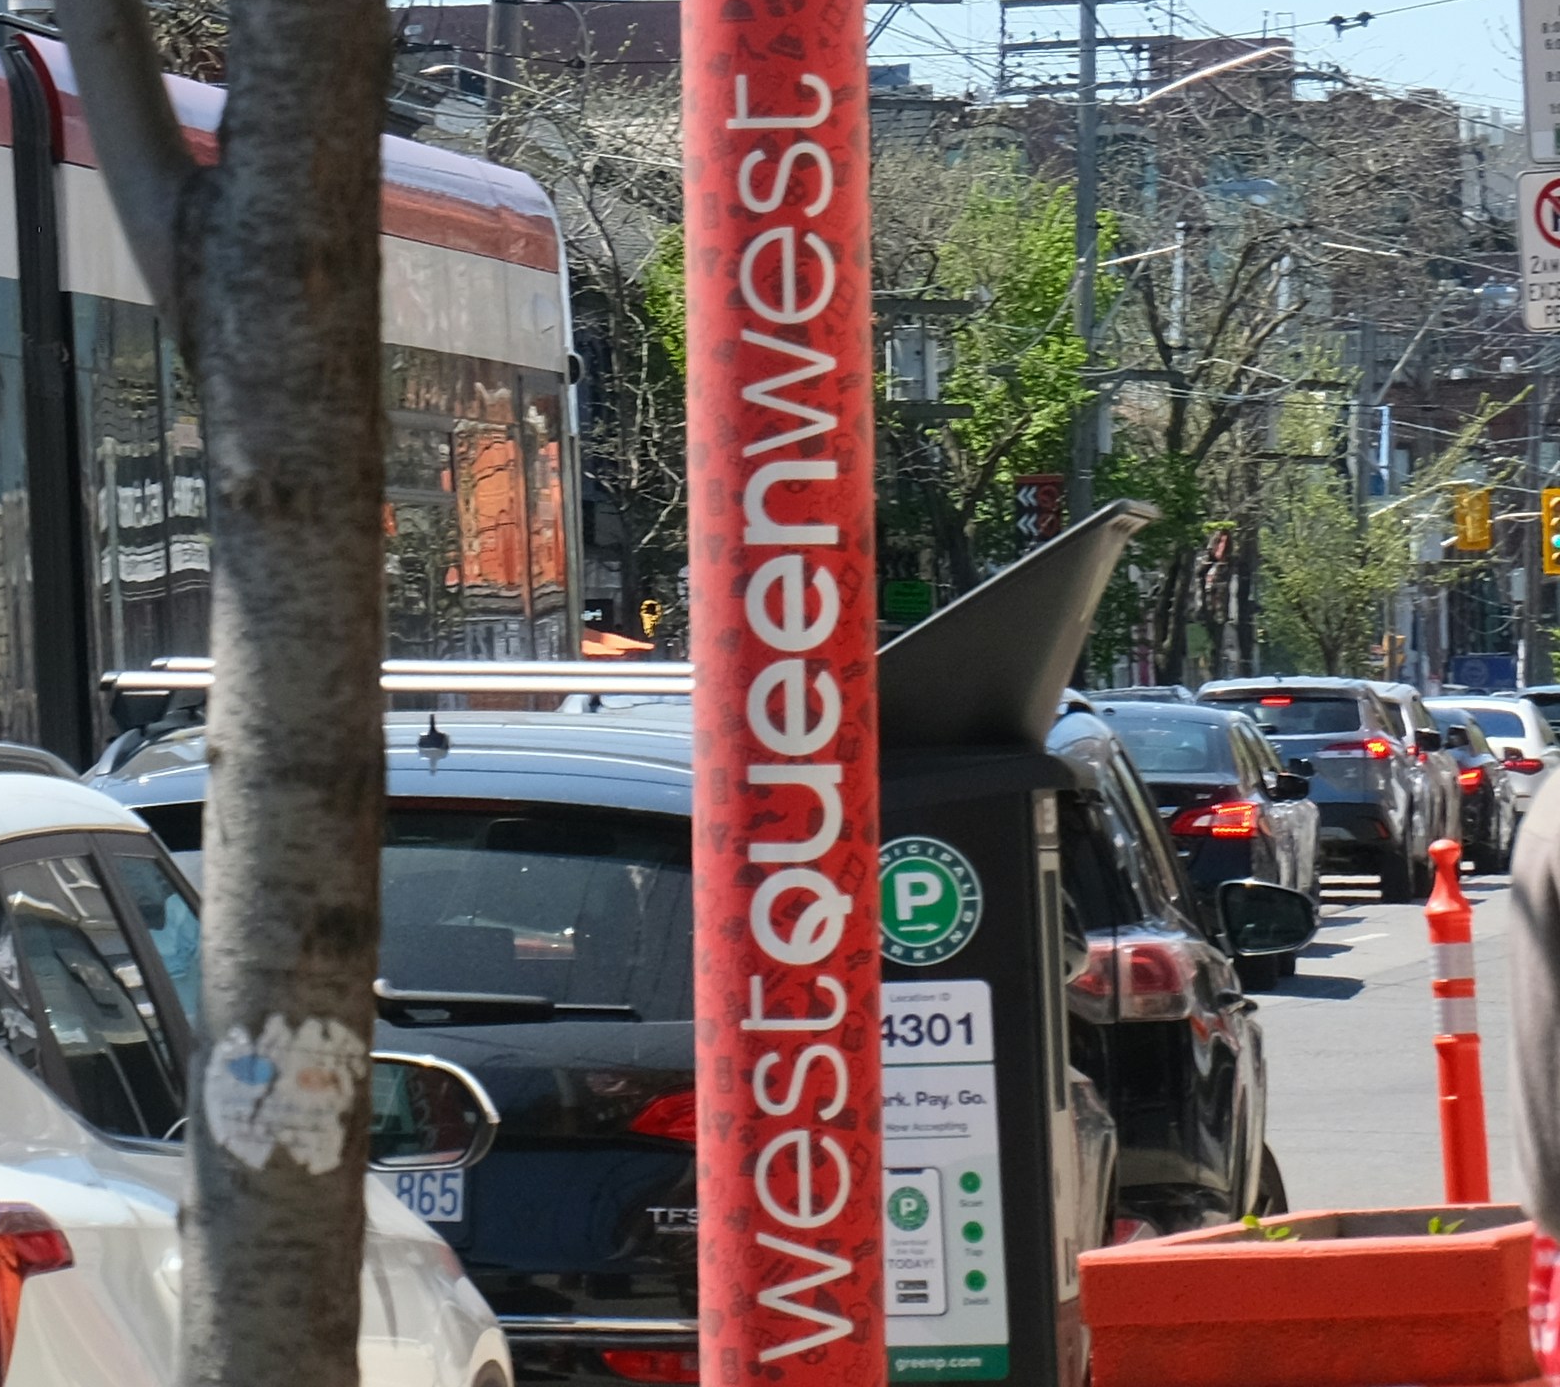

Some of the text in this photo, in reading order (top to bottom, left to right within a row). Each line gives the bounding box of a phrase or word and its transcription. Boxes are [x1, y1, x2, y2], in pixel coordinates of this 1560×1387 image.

[881, 1011, 975, 1047] 4301
[881, 1089, 987, 1111] ark. Pay. Go.
[397, 1172, 459, 1216] 865
[895, 1357, 982, 1372] greenp.com
